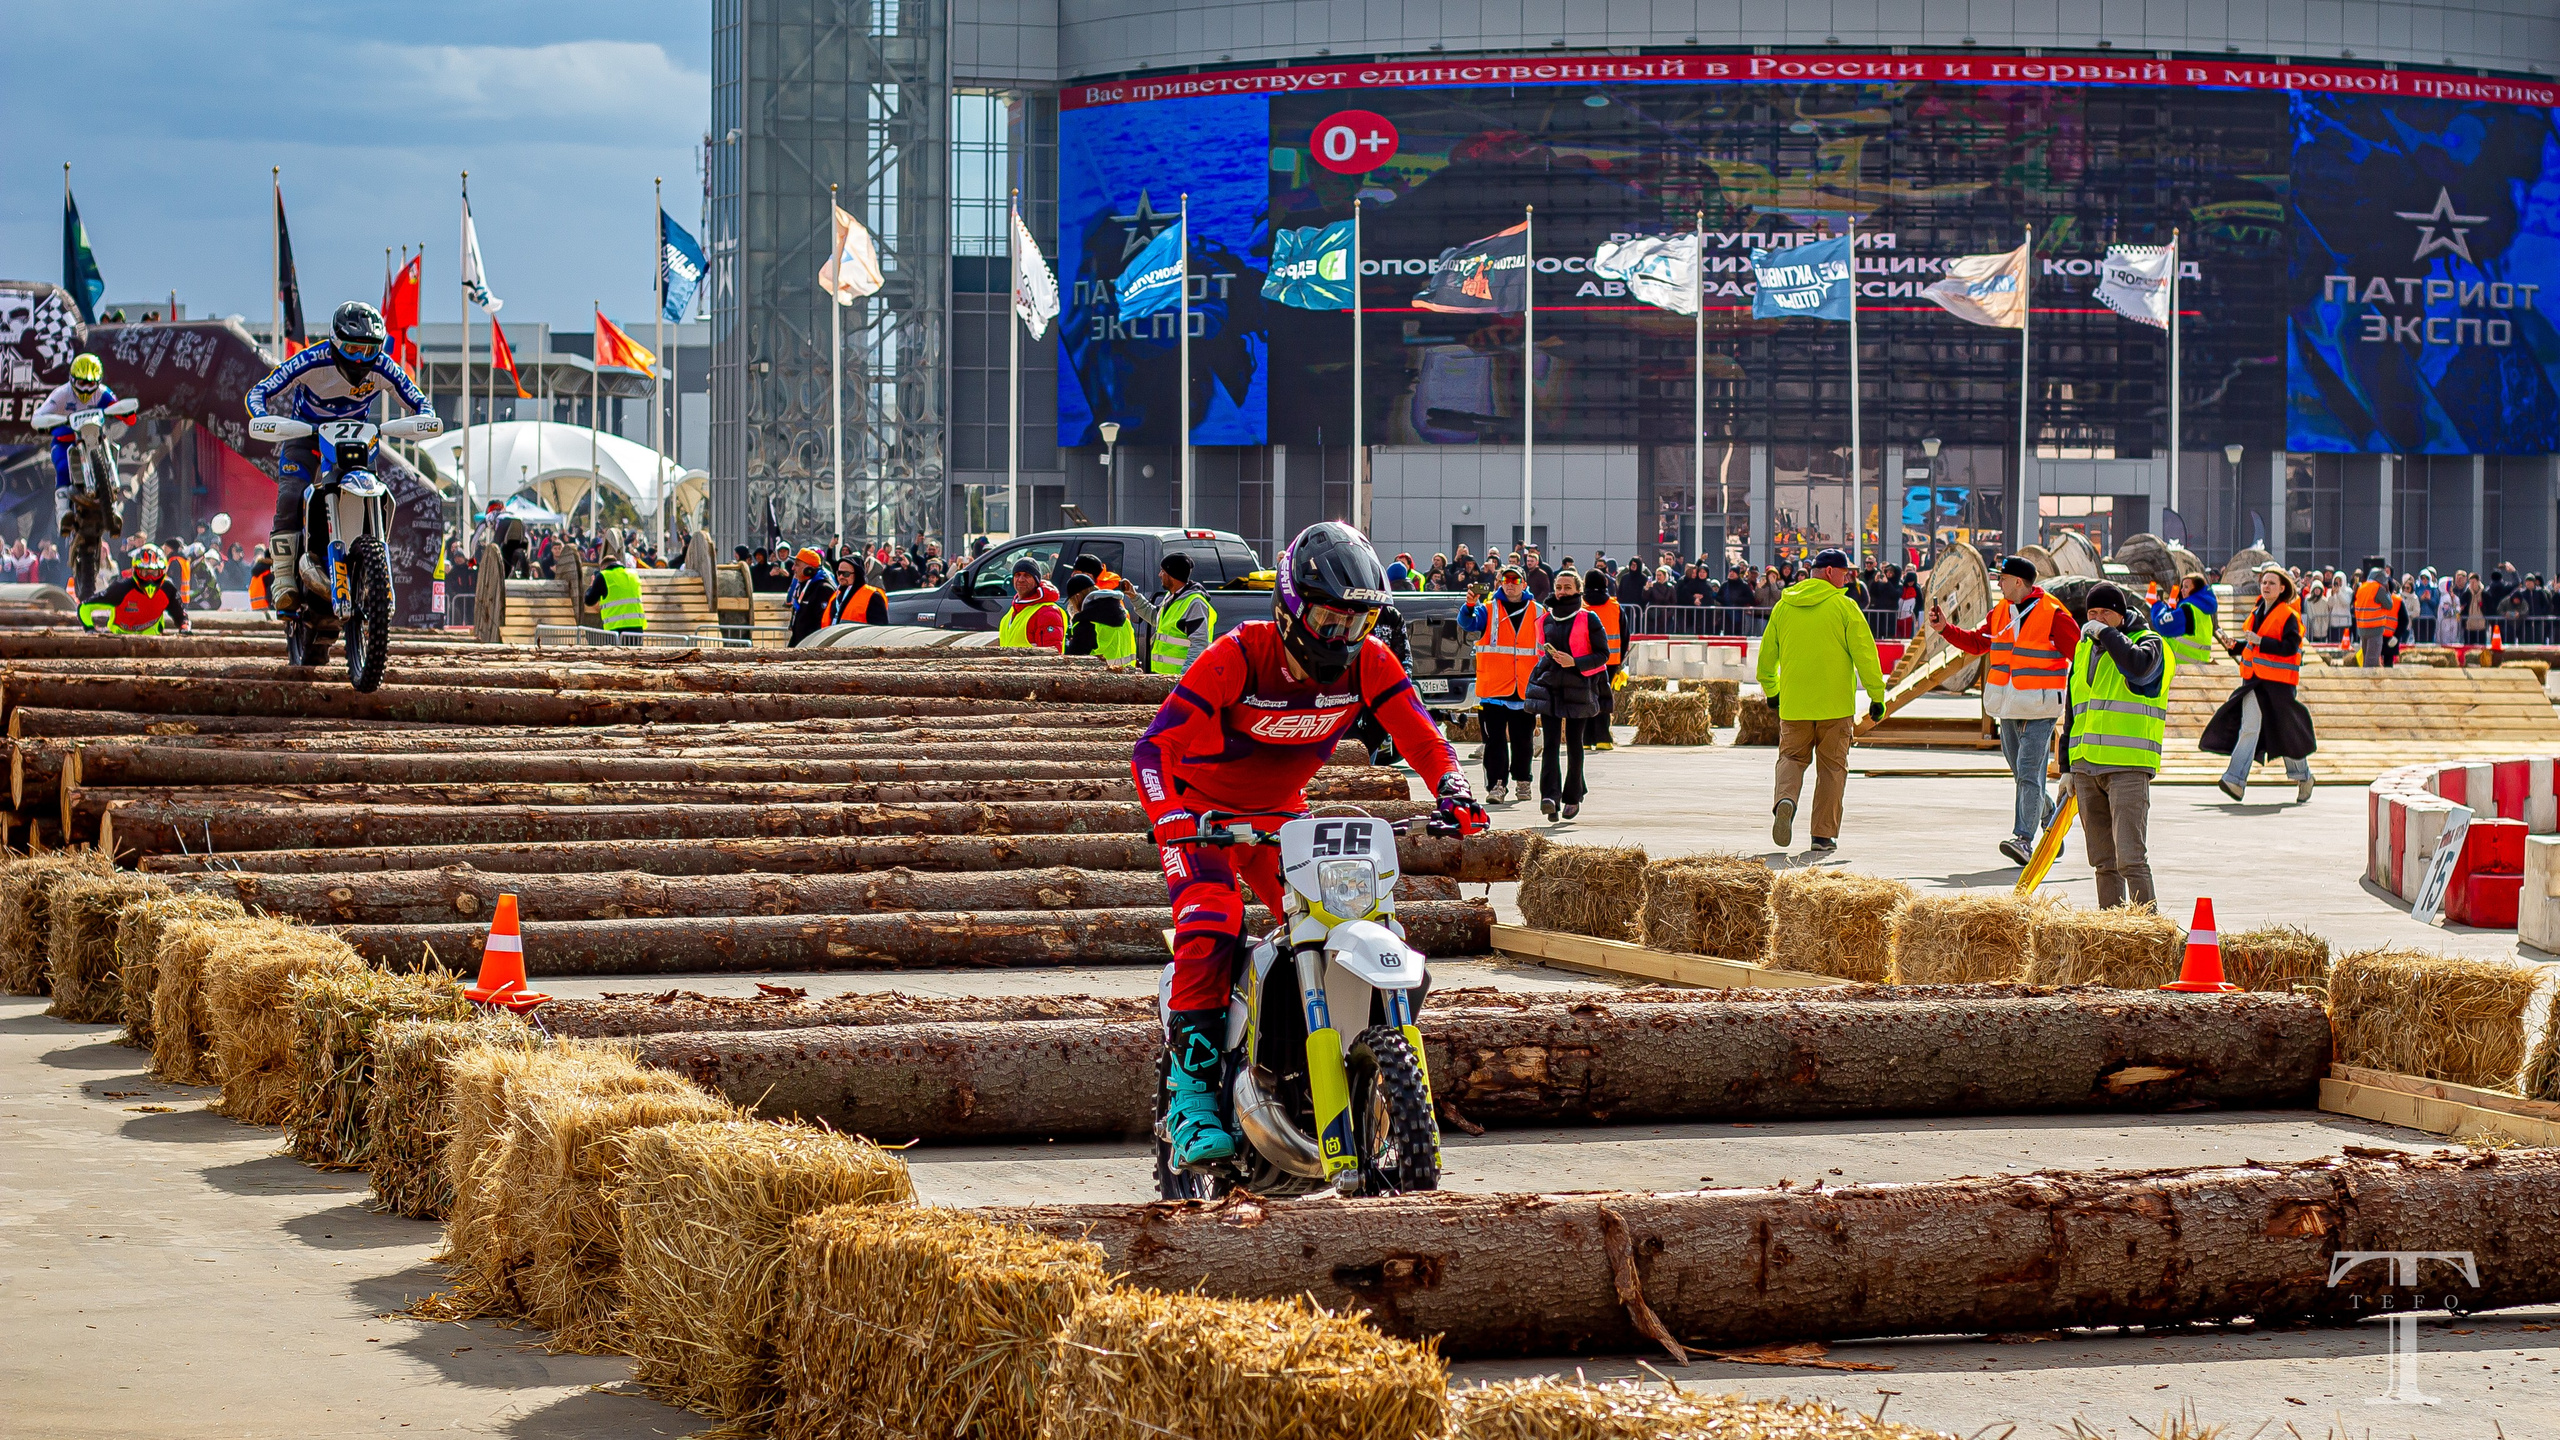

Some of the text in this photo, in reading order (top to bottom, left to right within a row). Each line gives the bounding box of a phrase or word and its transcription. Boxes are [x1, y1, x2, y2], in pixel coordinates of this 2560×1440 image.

[1085, 58, 2555, 105] Вас приветствует единственный в России и первый в мировой практике
[1323, 126, 1390, 162] 0+
[2324, 275, 2540, 311] ПАТРИОТ
[2361, 315, 2512, 346] ЭКСПО
[253, 421, 277, 432] DRC
[334, 423, 364, 439] 27
[417, 421, 439, 432] DRC
[335, 561, 352, 601] DRC
[1343, 588, 1390, 602] LEATT
[1250, 709, 1349, 739] LEATT
[1141, 768, 1166, 802] LEATT
[1312, 822, 1373, 858] 56
[1162, 846, 1188, 878] ATT
[2421, 850, 2455, 912] 15
